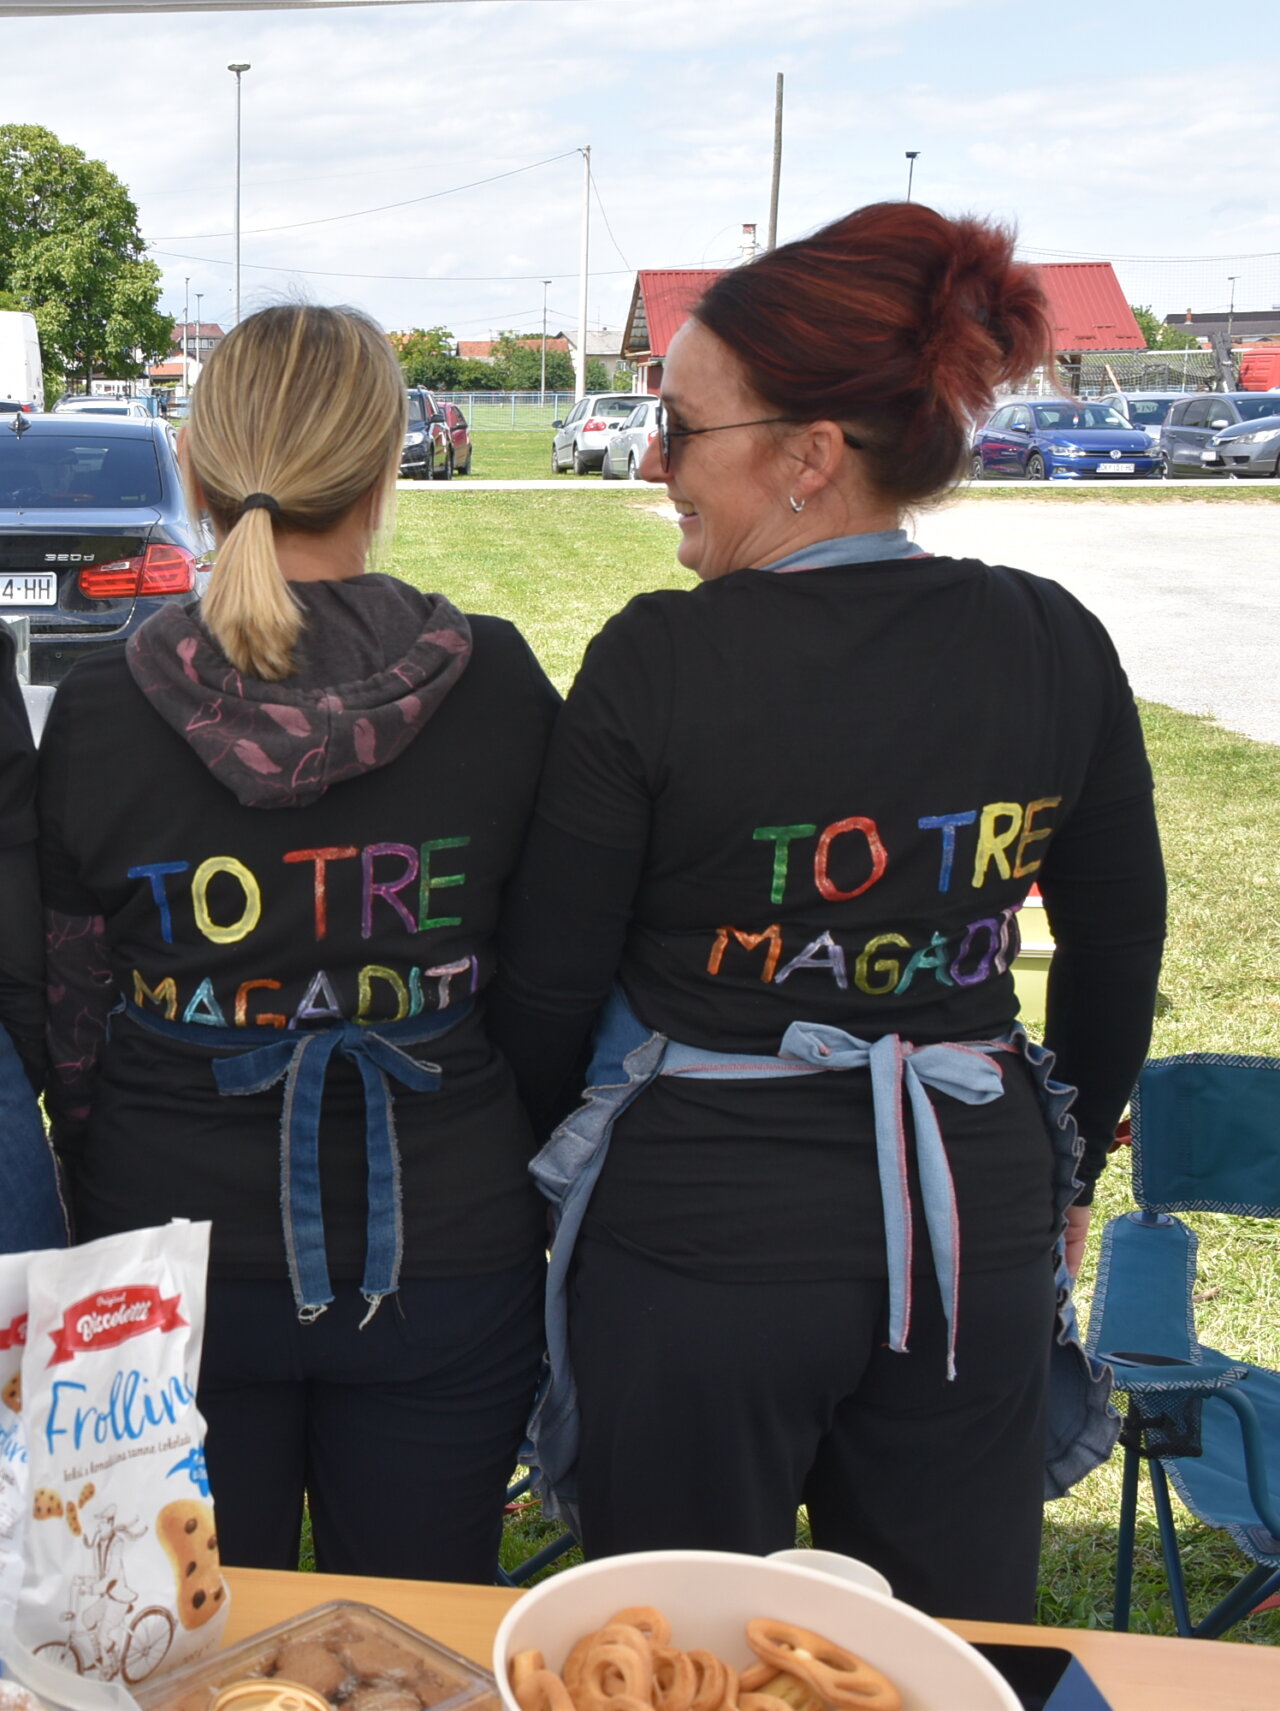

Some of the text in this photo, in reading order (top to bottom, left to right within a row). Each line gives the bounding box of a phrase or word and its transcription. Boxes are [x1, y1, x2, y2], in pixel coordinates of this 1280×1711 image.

[45, 553, 95, 562] 320d
[127, 835, 472, 944] TO TRE
[752, 795, 1063, 904] TO TRE
[132, 954, 479, 1030] MAGADITI
